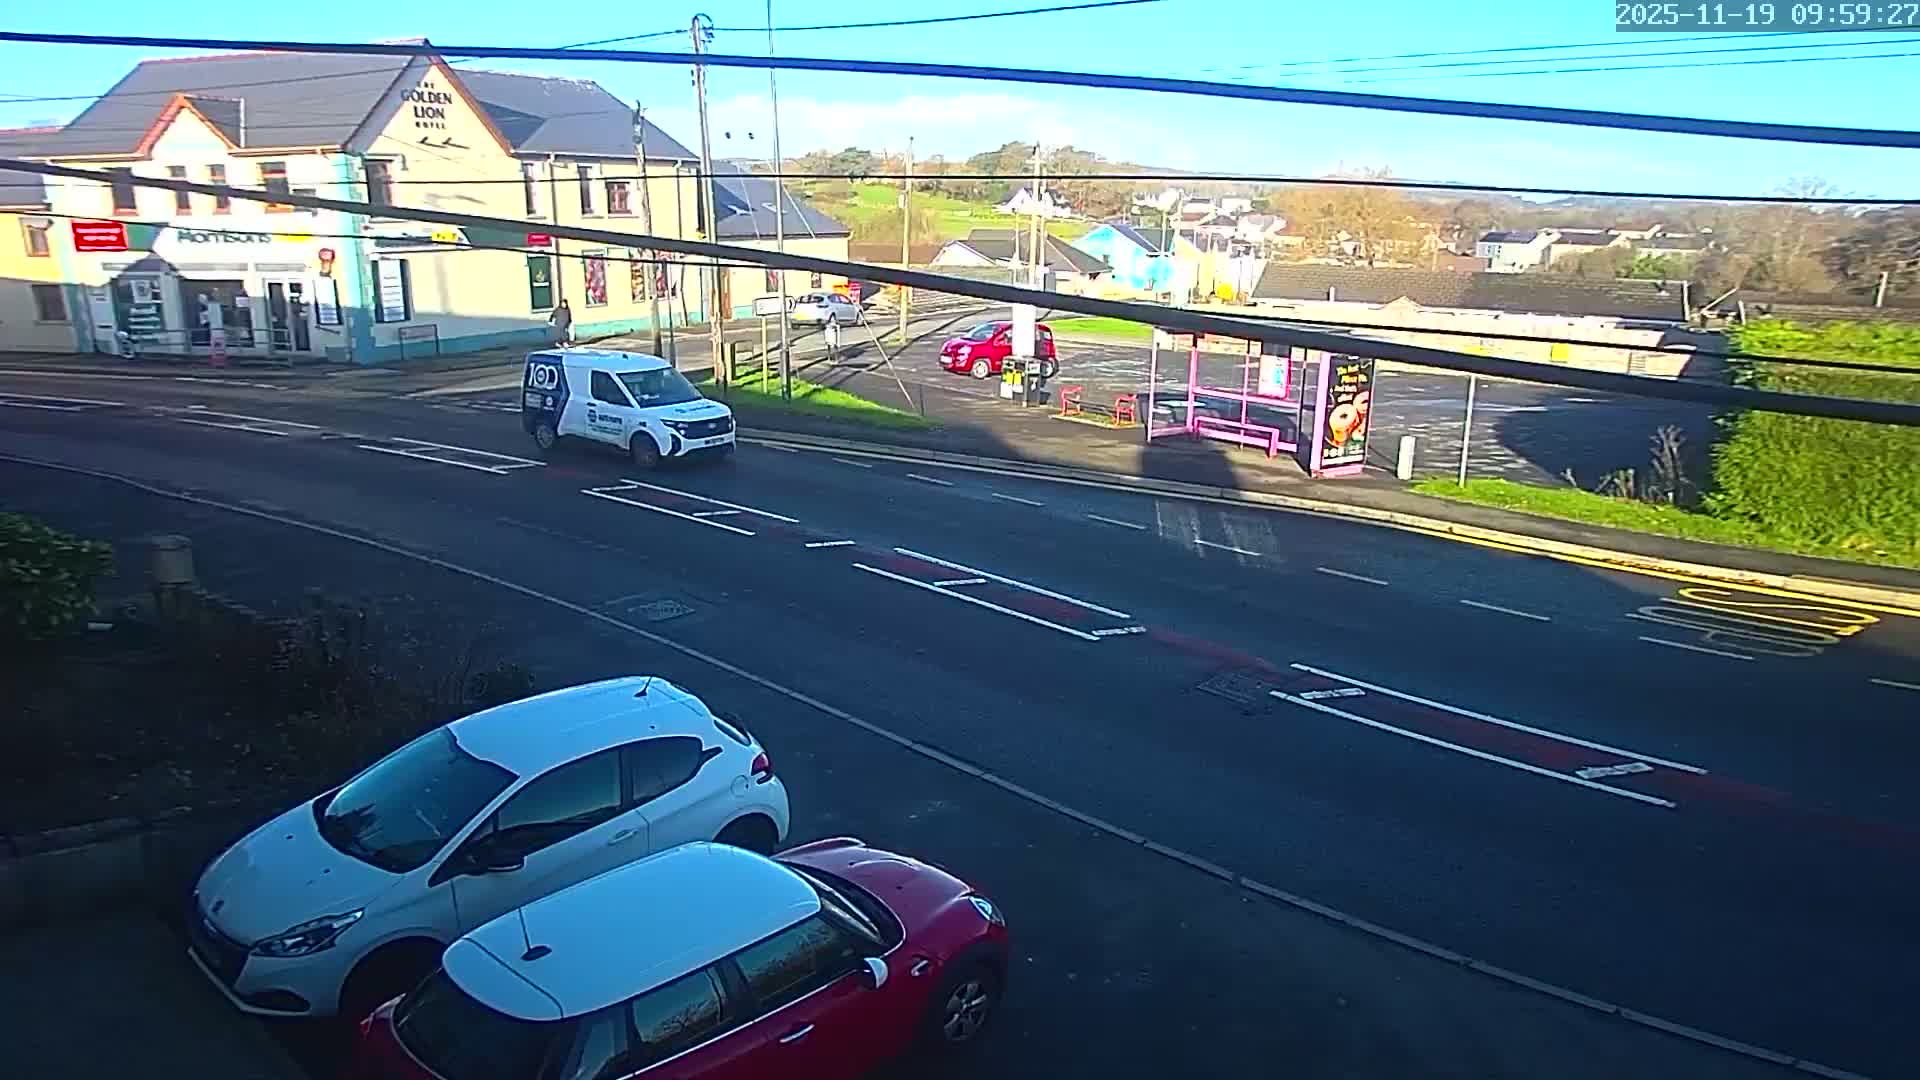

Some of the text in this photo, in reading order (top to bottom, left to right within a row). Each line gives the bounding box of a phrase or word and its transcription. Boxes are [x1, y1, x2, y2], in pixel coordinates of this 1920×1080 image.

[400, 88, 453, 105] GOLDEN
[413, 104, 446, 119] LION
[415, 120, 447, 130] HOTEL
